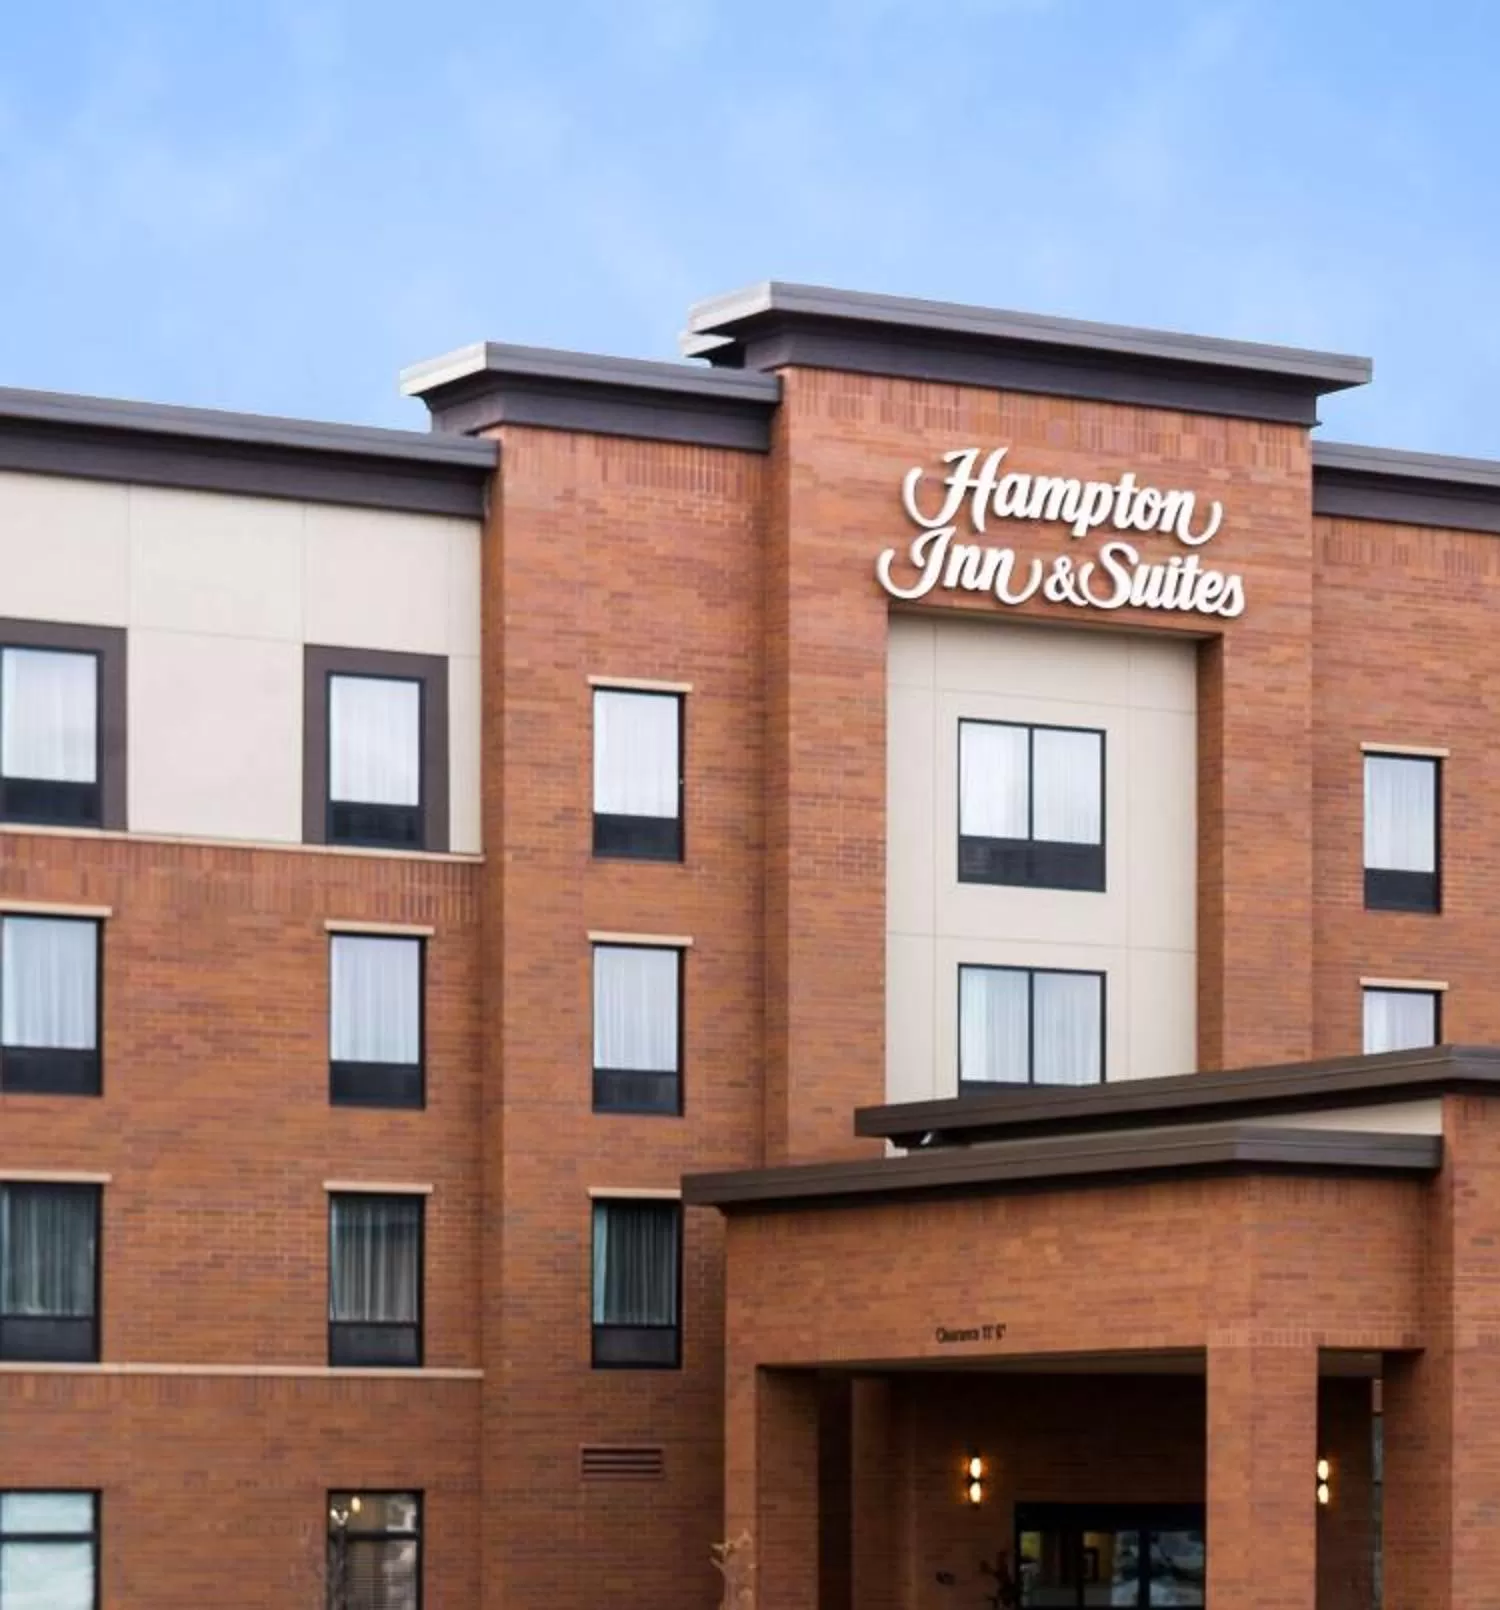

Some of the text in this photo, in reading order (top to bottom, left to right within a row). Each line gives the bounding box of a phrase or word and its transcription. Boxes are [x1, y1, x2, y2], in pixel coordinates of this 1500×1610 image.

[904, 447, 1223, 545] Hampton
[877, 526, 1246, 617] Inn & Suites
